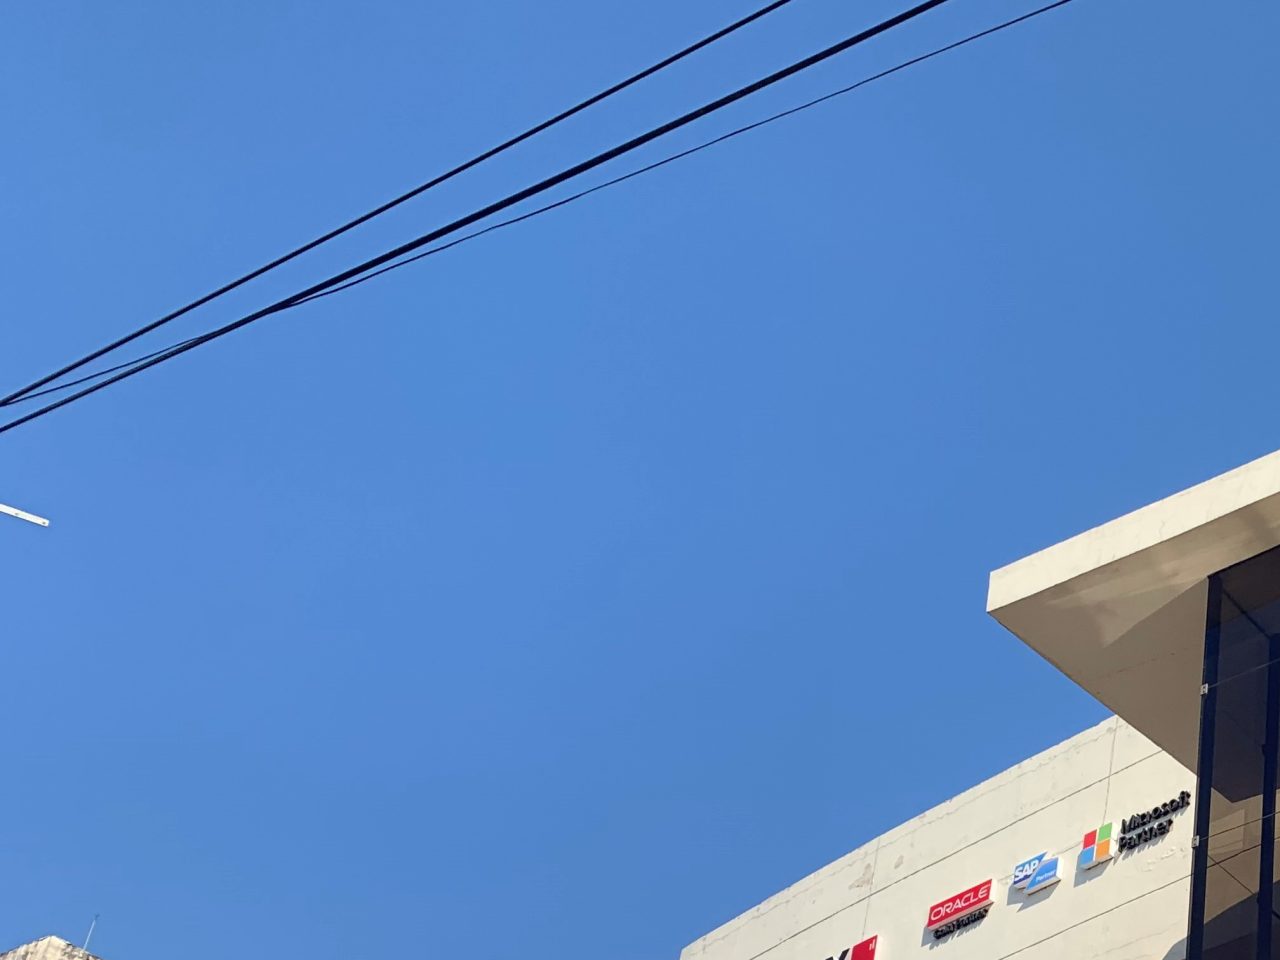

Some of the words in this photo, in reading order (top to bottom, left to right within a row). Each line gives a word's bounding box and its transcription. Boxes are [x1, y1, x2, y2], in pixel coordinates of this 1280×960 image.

[1120, 790, 1191, 834] Microsoft
[1118, 819, 1173, 853] Partner
[1014, 859, 1039, 881] SAP
[1036, 869, 1056, 883] Partner
[930, 884, 990, 921] ORACLE
